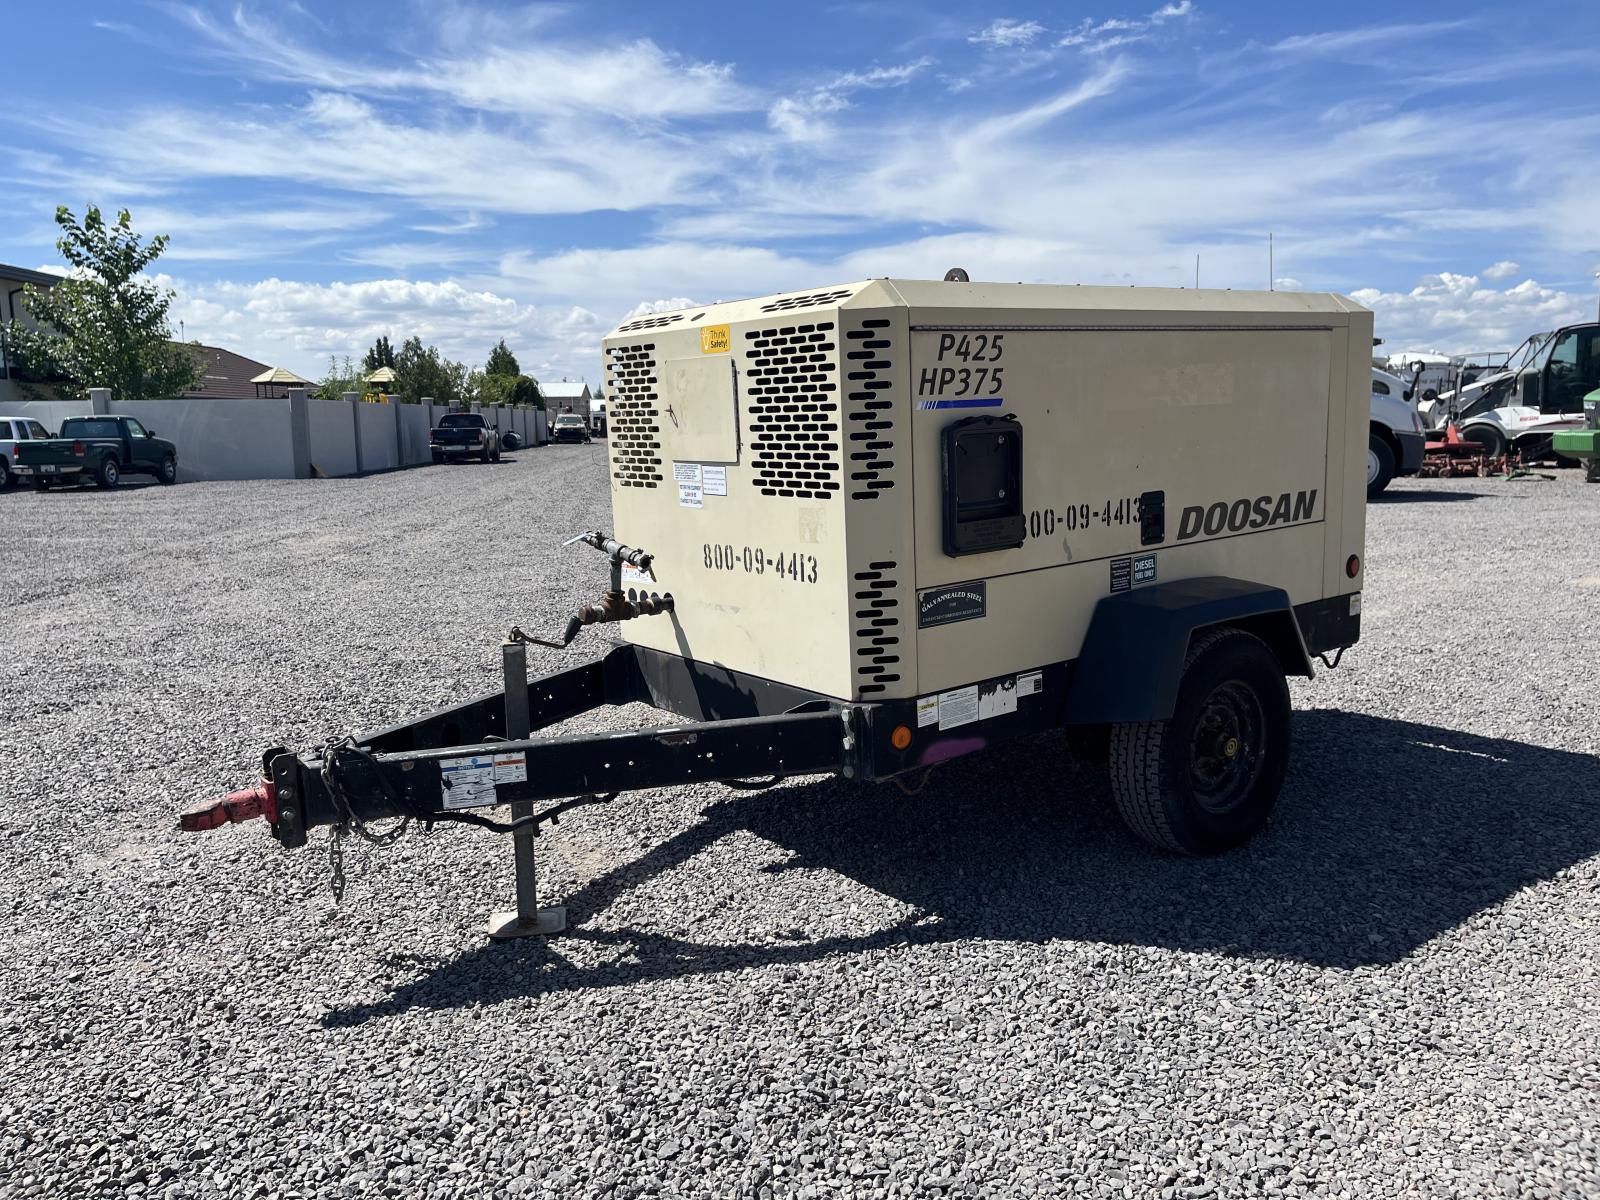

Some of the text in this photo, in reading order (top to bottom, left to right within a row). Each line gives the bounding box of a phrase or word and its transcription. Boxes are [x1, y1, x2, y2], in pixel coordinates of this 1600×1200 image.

[710, 328, 726, 339] Think
[710, 339, 728, 348] Safety!
[938, 334, 1004, 362] P425
[918, 368, 1004, 396] HP375
[1177, 489, 1317, 540] DOOSAN
[703, 544, 818, 584] 800-09-4413
[1134, 558, 1154, 571] DIESEL
[966, 592, 982, 603] STEEL
